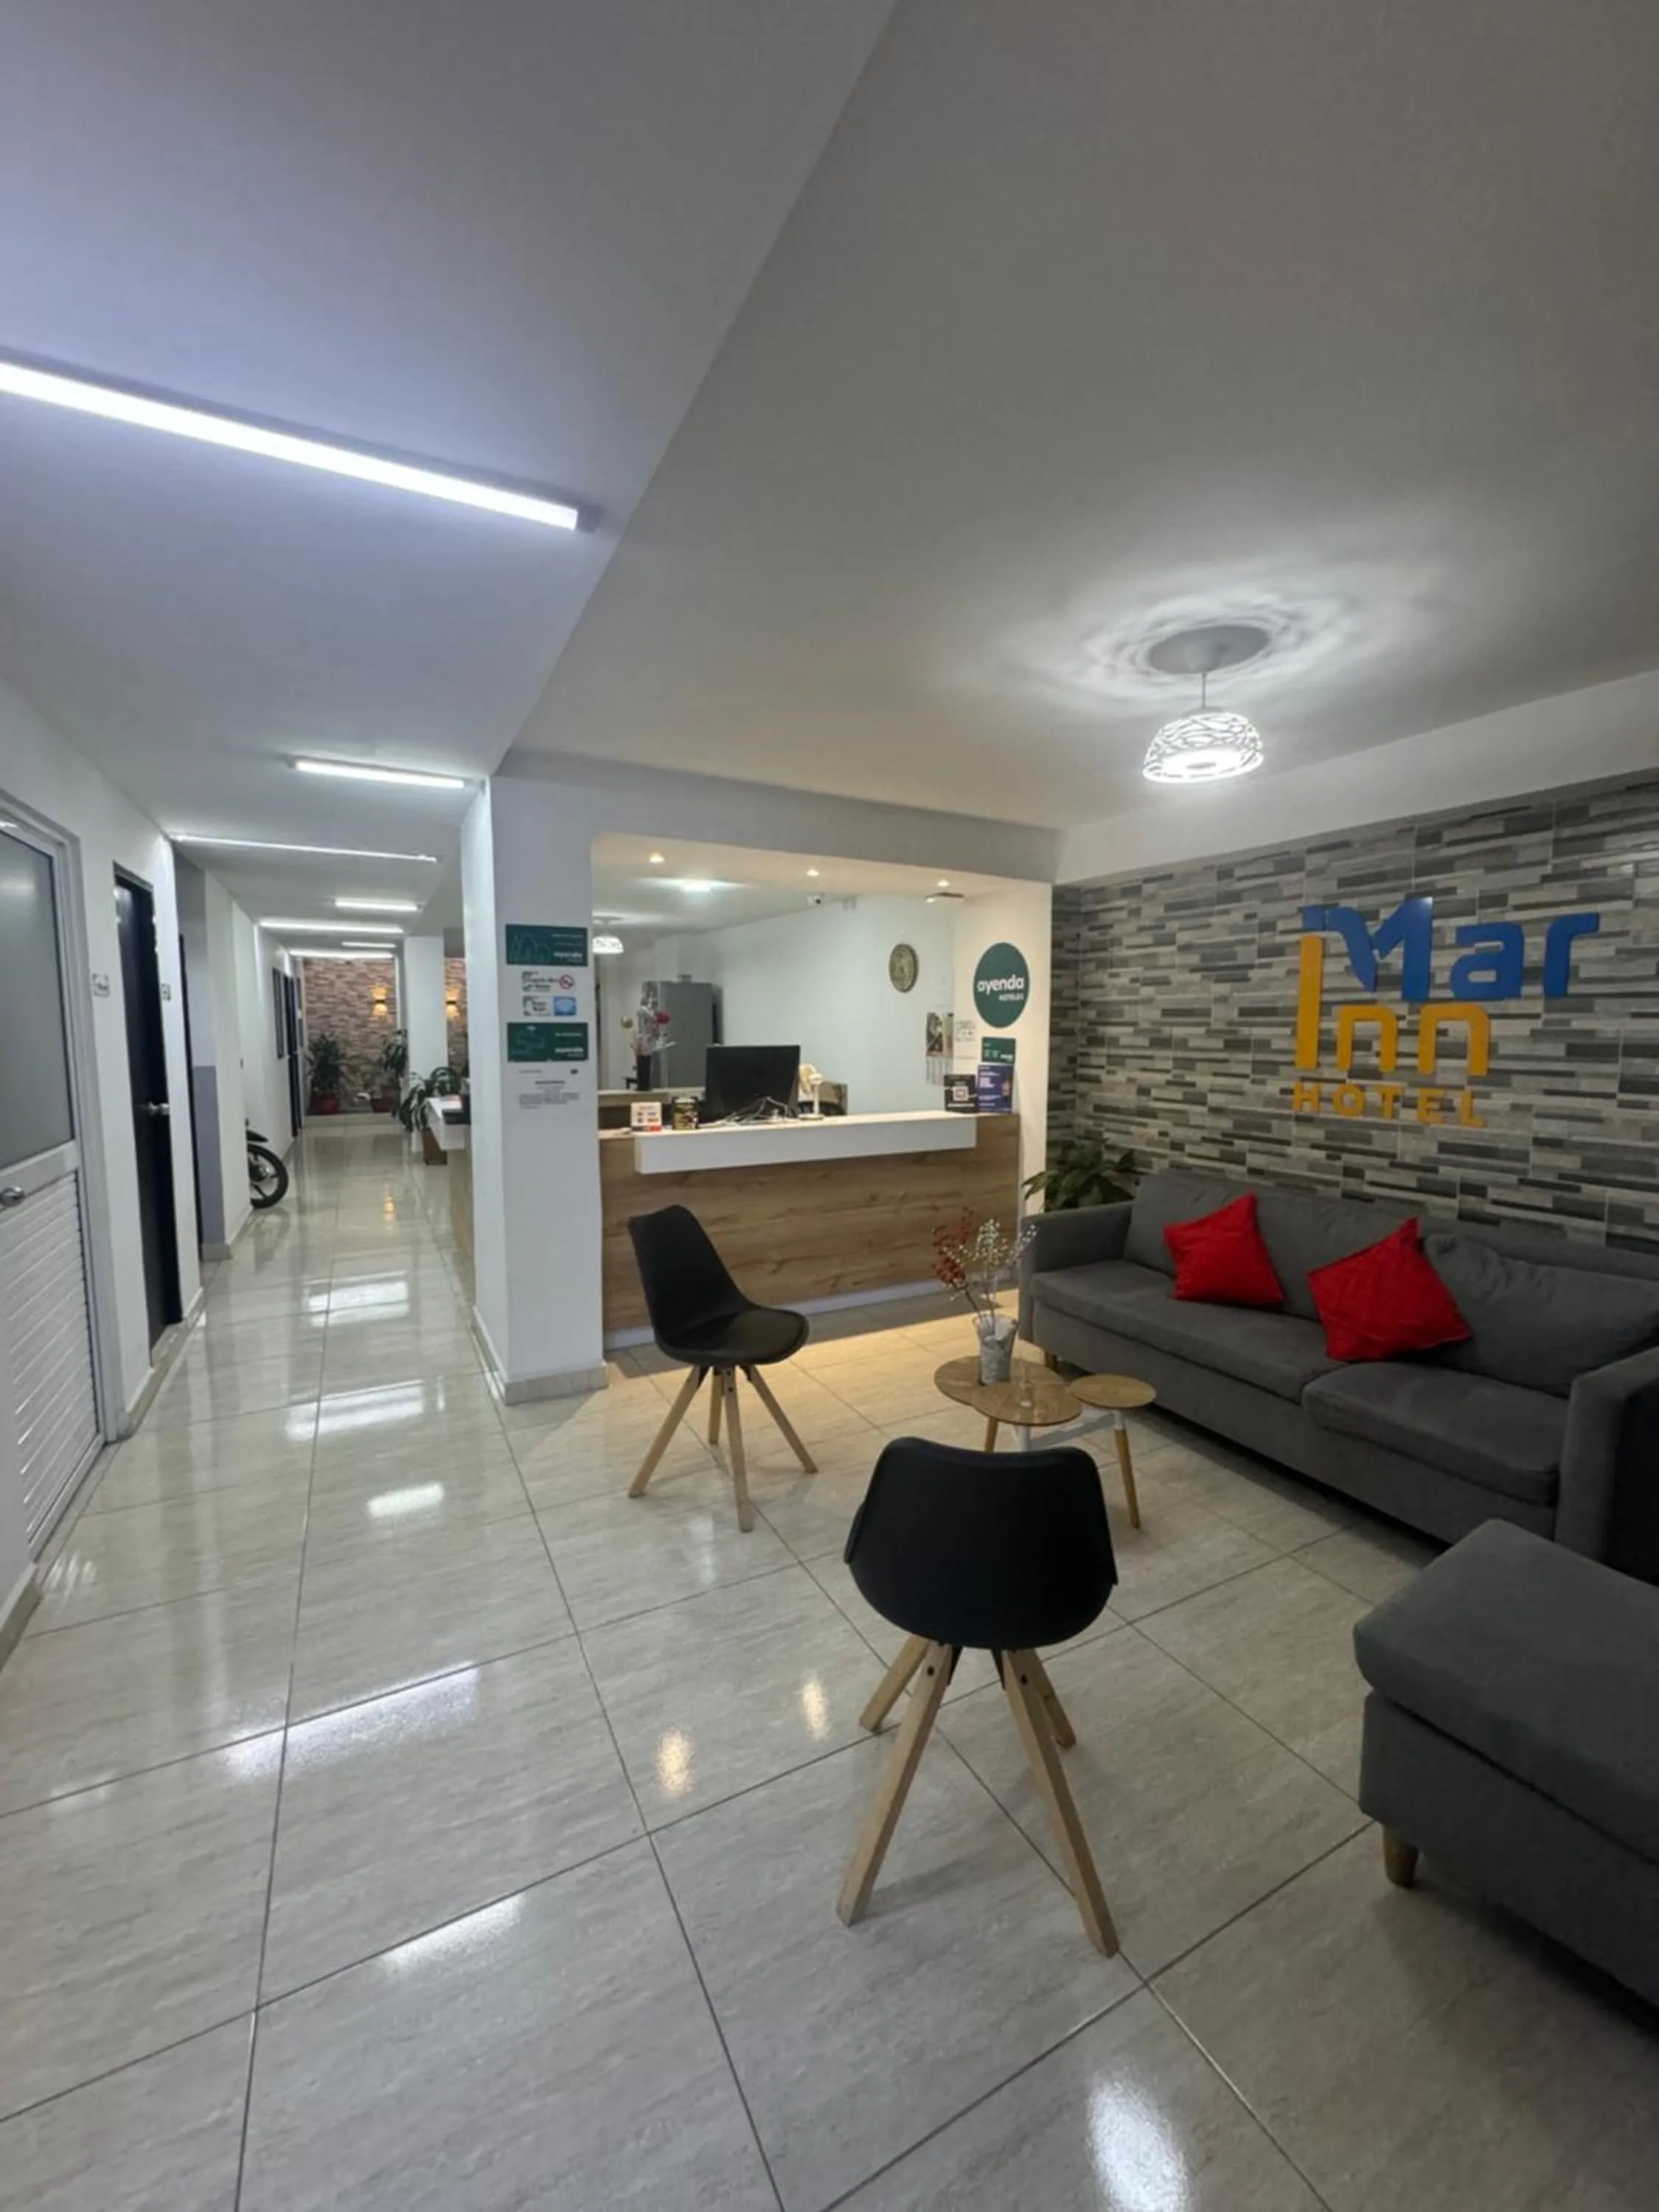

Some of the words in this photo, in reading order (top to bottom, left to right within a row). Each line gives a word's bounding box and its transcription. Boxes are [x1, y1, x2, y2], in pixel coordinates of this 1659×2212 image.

[977, 974, 1024, 995] ayenda
[1302, 897, 1600, 1003] Mar
[1295, 934, 1490, 1076] Inn
[1293, 1081, 1486, 1128] HOTEL
